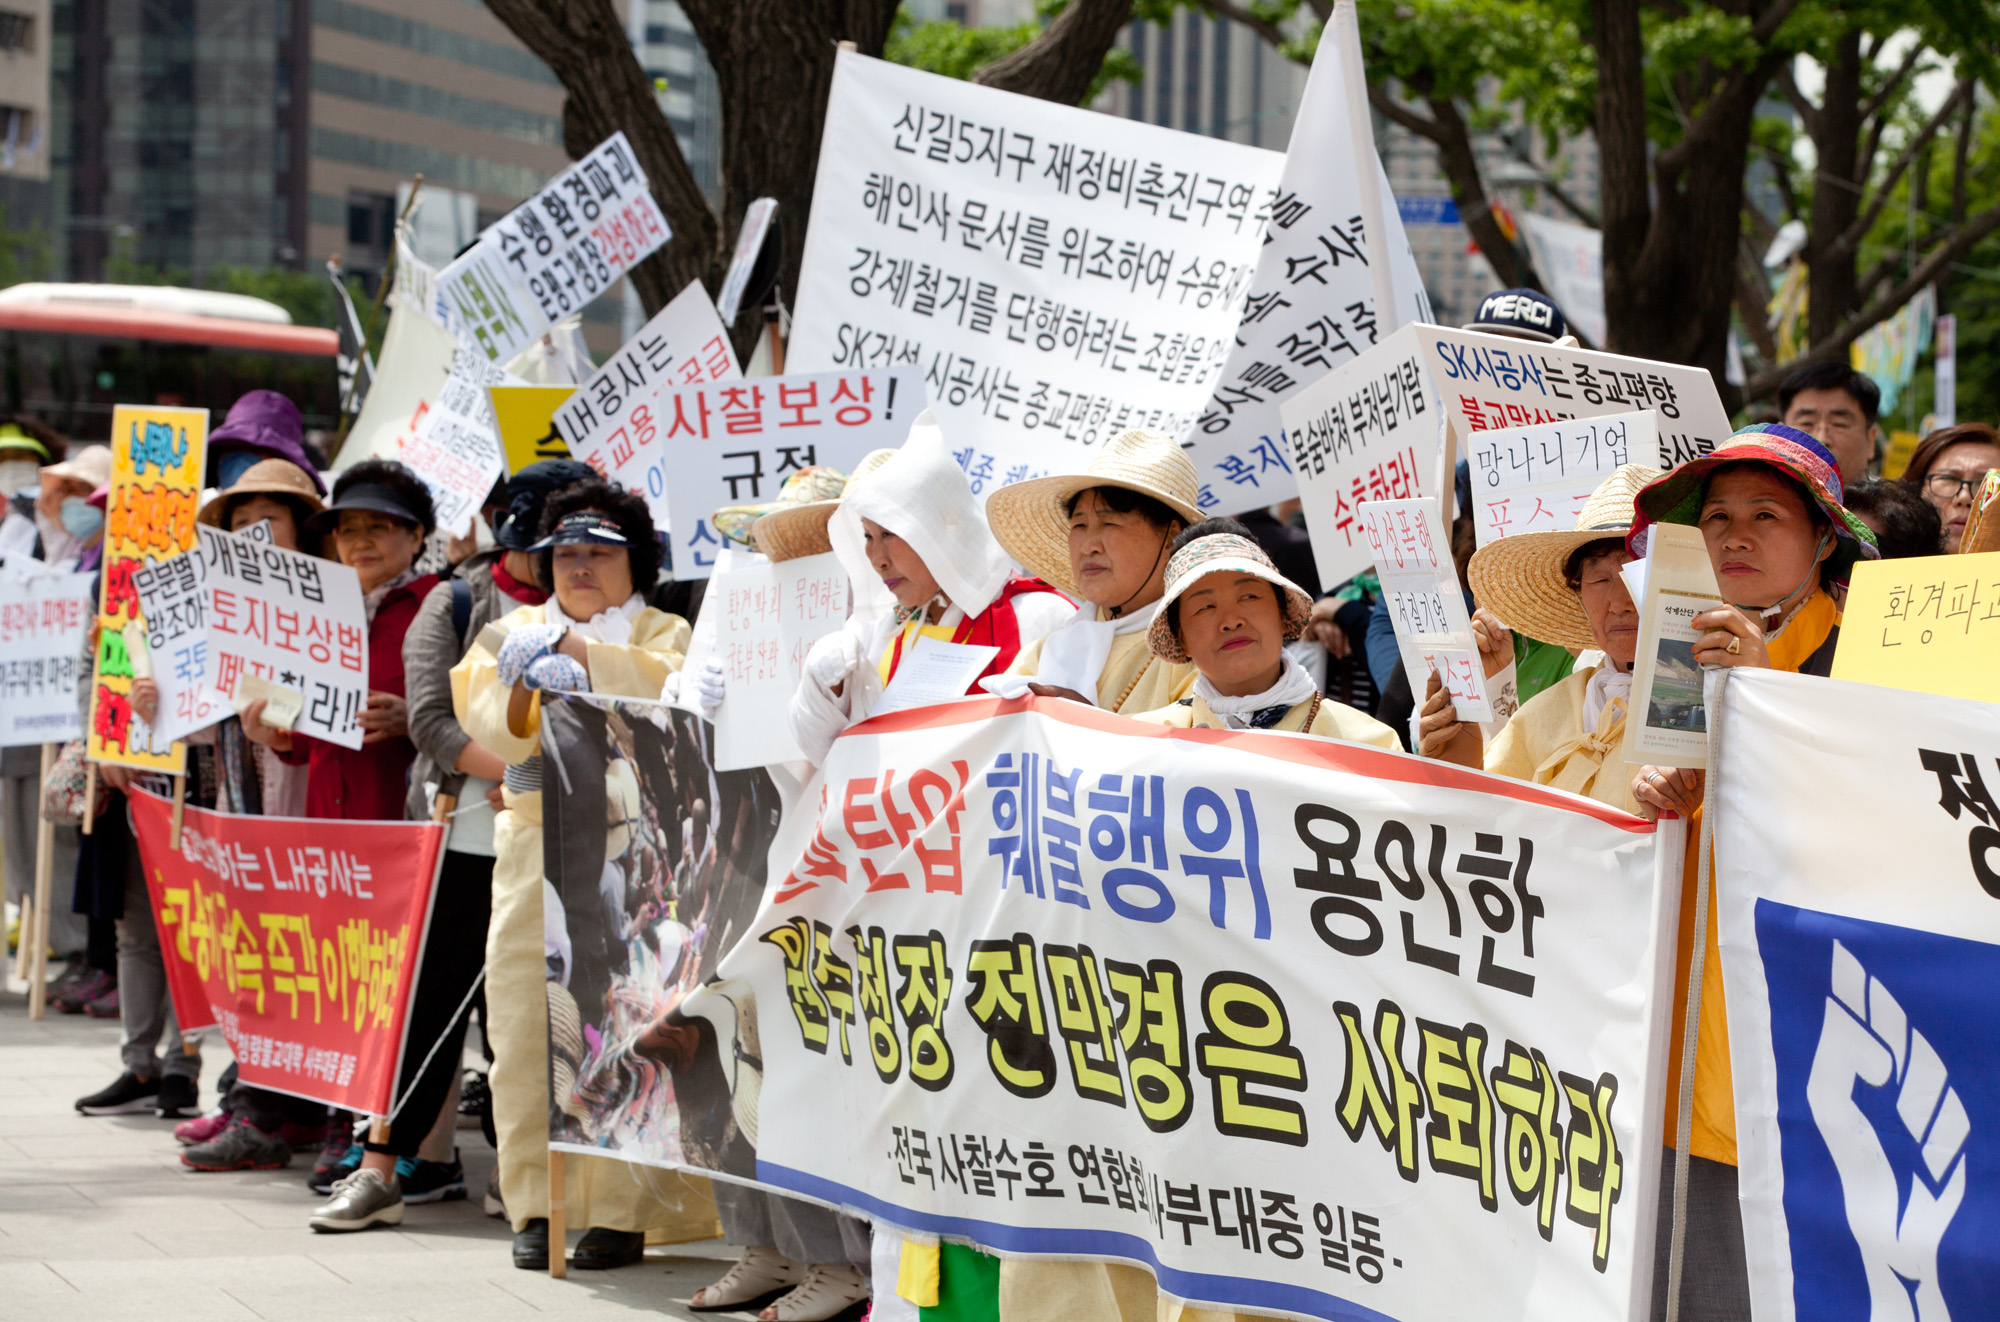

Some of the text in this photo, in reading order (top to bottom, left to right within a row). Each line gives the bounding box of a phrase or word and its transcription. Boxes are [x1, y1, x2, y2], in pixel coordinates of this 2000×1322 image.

[894, 104, 1036, 182] 신길5지구
[1044, 142, 1255, 235] 재정비촉진구역
[863, 173, 951, 241] 해인사
[958, 200, 1050, 268] 문서를
[1058, 227, 1175, 300] 위조하여
[848, 247, 998, 335] 강제철거를
[1007, 293, 1138, 373] 단행하려는
[1276, 313, 1361, 370] 즉각
[1479, 294, 1553, 328] MERCI
[667, 376, 899, 441] 사찰보상!
[926, 351, 1021, 422] 시공사는
[1022, 381, 1112, 446] 종교편향
[1291, 354, 1426, 481] 목숨바쳐 부처님가람
[204, 530, 325, 604] 개발악법
[1367, 509, 1438, 571] 여성폭행
[211, 588, 364, 674] 토지보상법
[986, 752, 1272, 941] 훼불행위
[1292, 802, 1546, 998] 용인한
[759, 915, 1624, 1275] 원주청장 전만경은 사퇴하라
[939, 1132, 1065, 1200] 사찰수호
